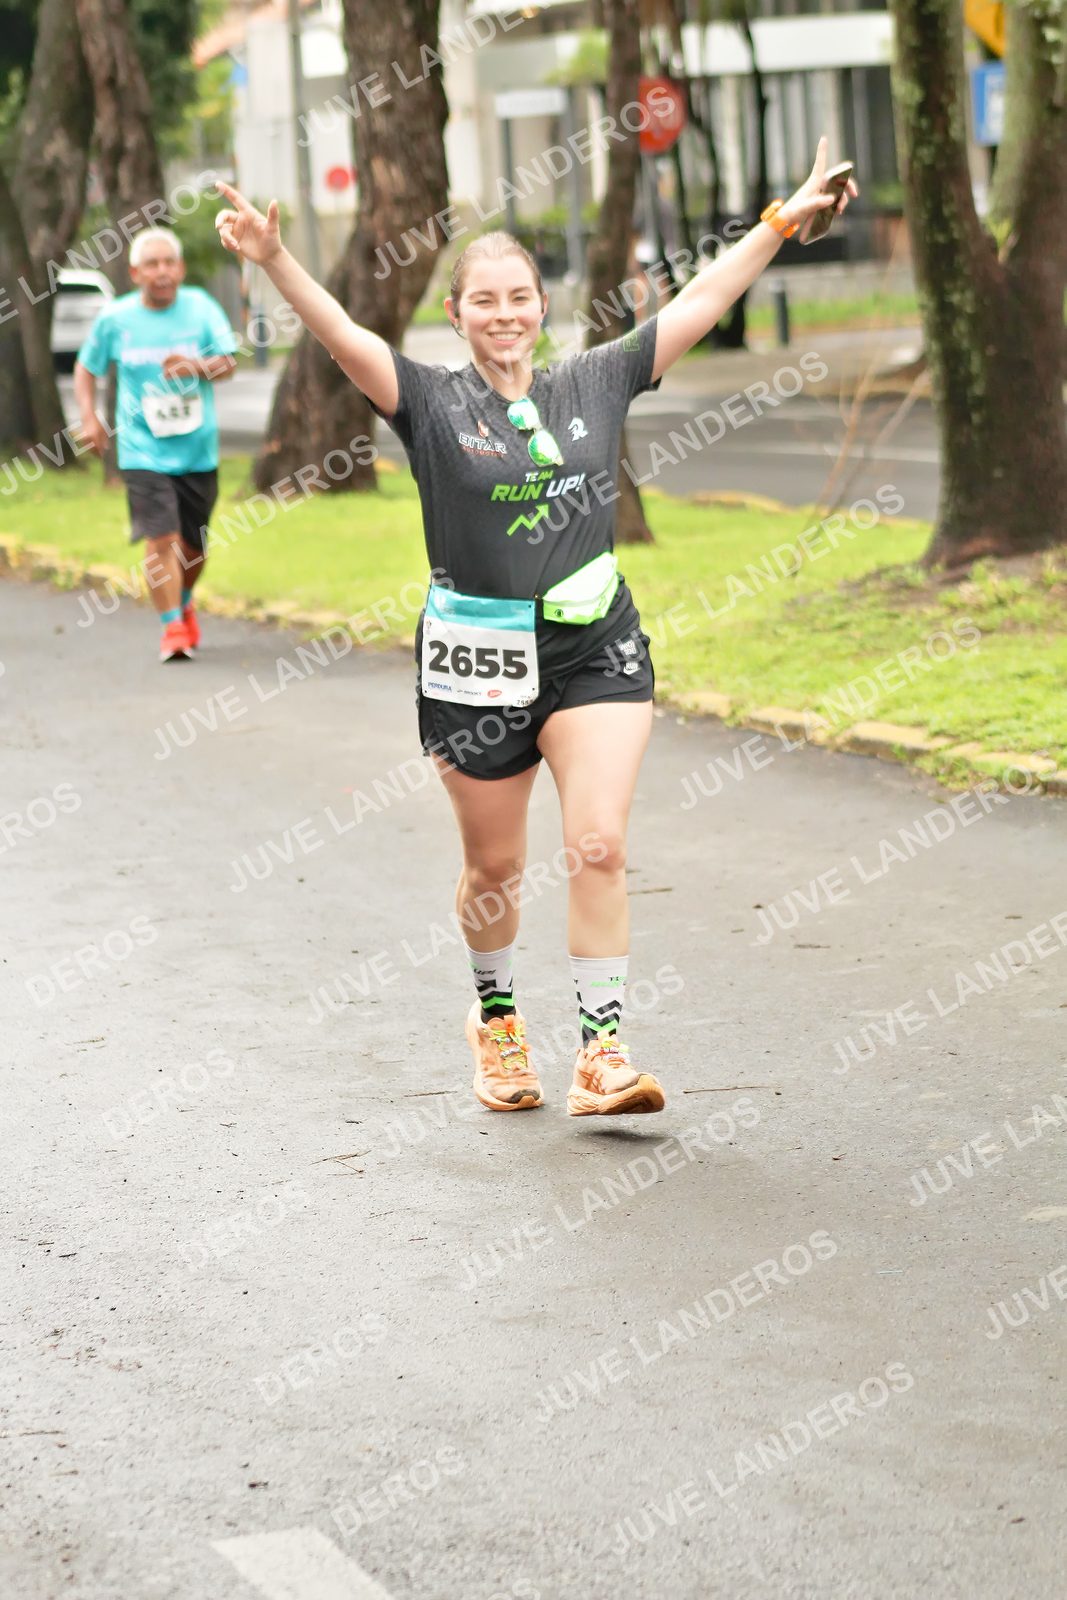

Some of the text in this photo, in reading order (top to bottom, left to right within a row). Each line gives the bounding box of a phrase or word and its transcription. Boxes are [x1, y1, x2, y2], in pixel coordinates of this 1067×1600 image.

[459, 432, 508, 455] BITAR
[491, 472, 586, 502] RUN UP!
[525, 470, 553, 482] TEAM
[429, 640, 528, 680] 2655
